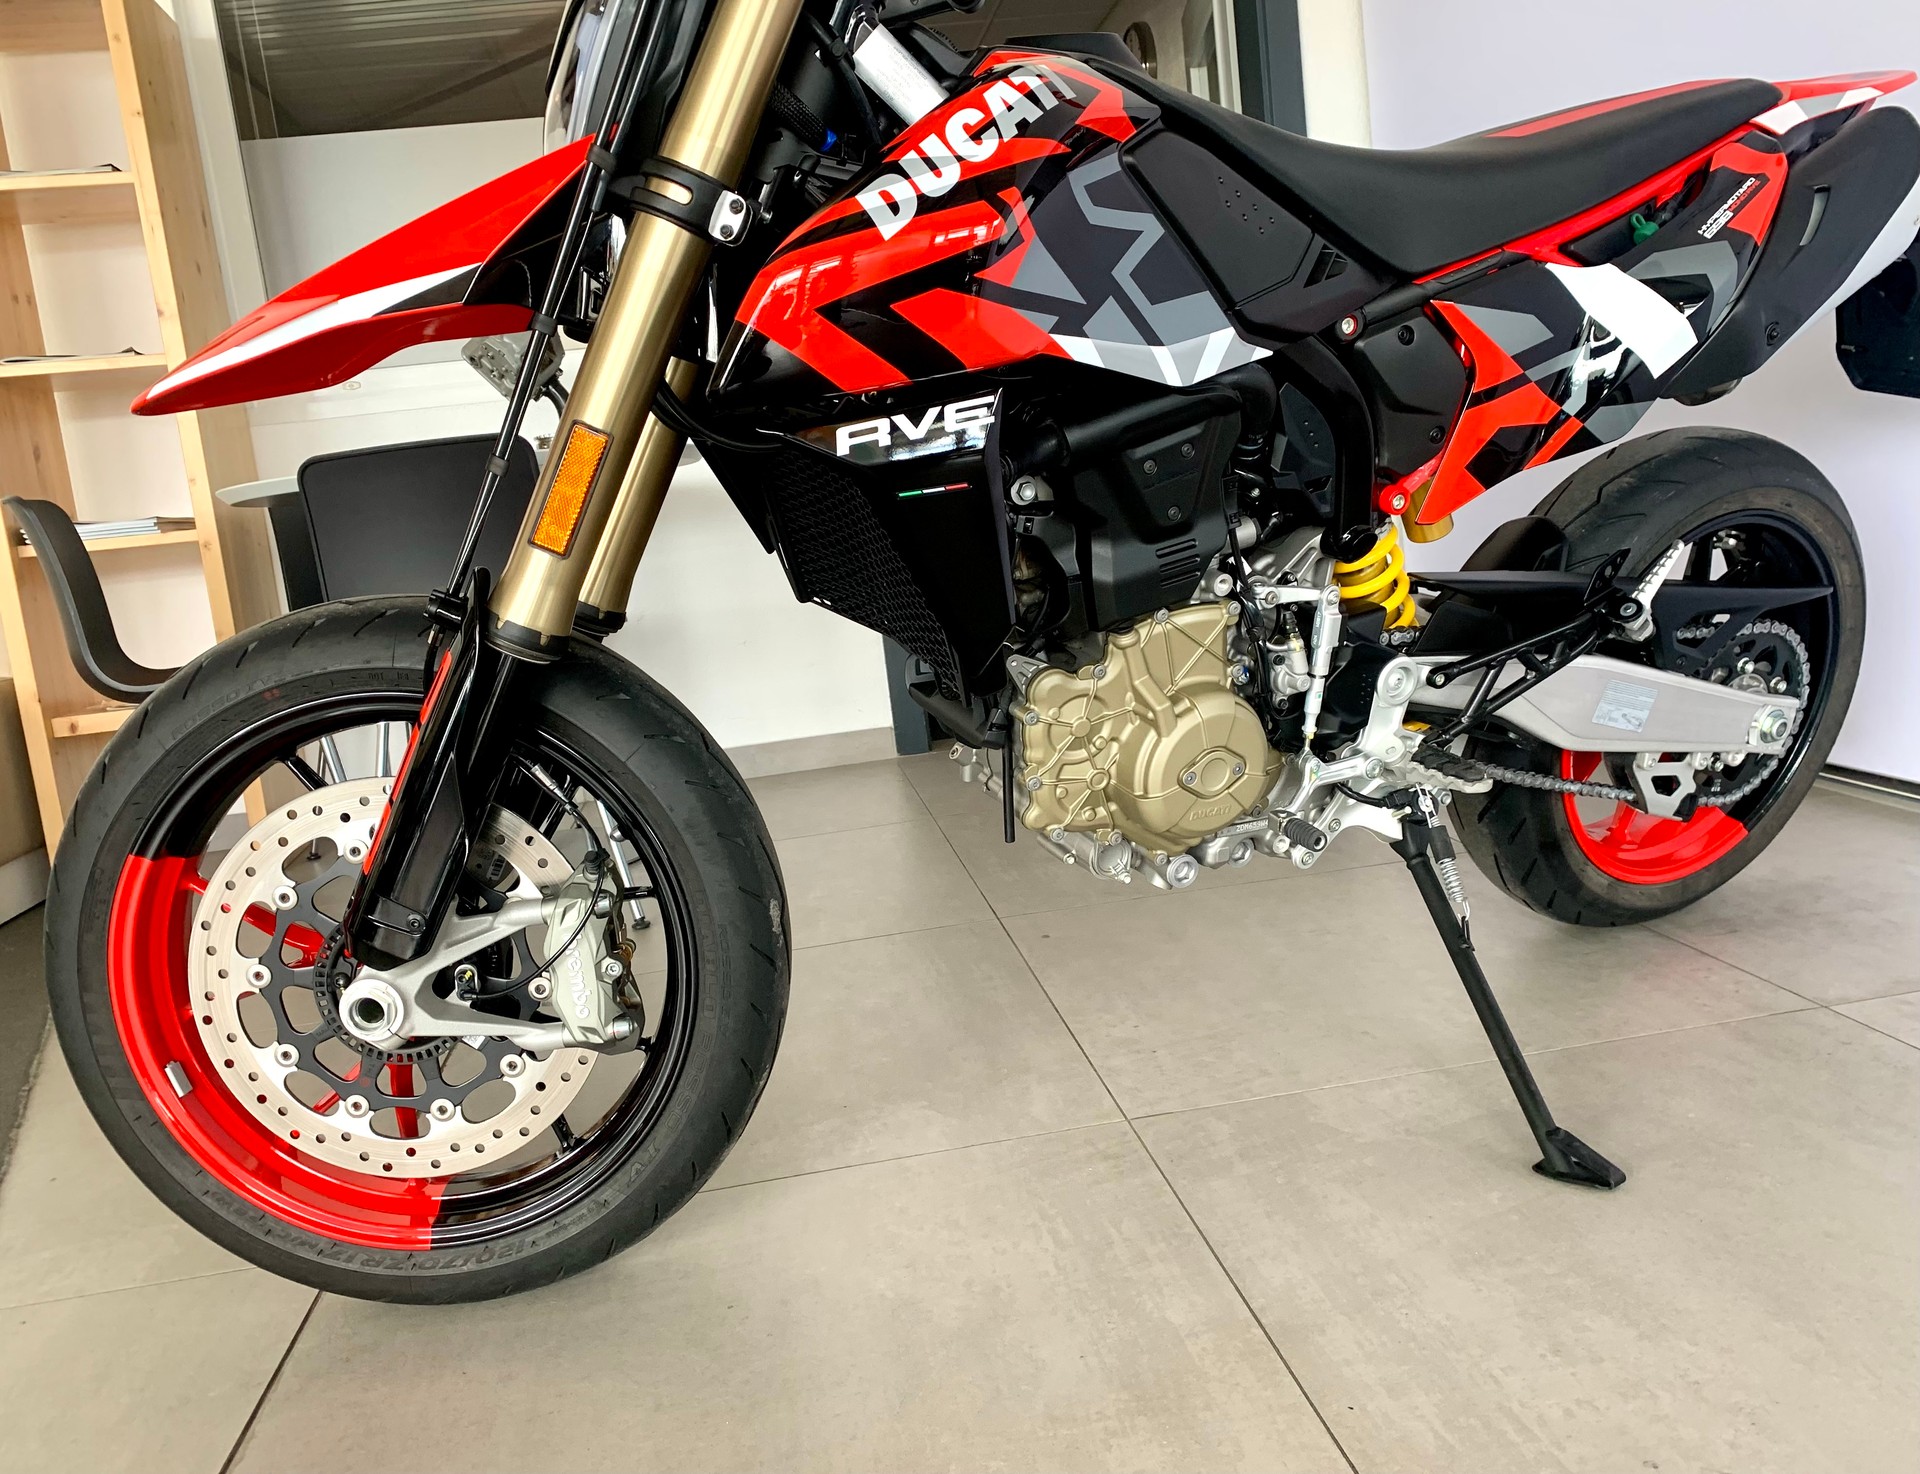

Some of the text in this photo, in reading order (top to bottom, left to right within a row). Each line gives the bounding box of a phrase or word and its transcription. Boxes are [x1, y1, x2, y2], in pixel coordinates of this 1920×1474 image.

[855, 64, 1076, 241] DUCATI
[1697, 177, 1756, 235] HYPERMOTARD
[1703, 210, 1734, 239] 698
[836, 395, 995, 457] RVE
[1189, 804, 1232, 821] DUCATI
[562, 932, 593, 1019] brembo
